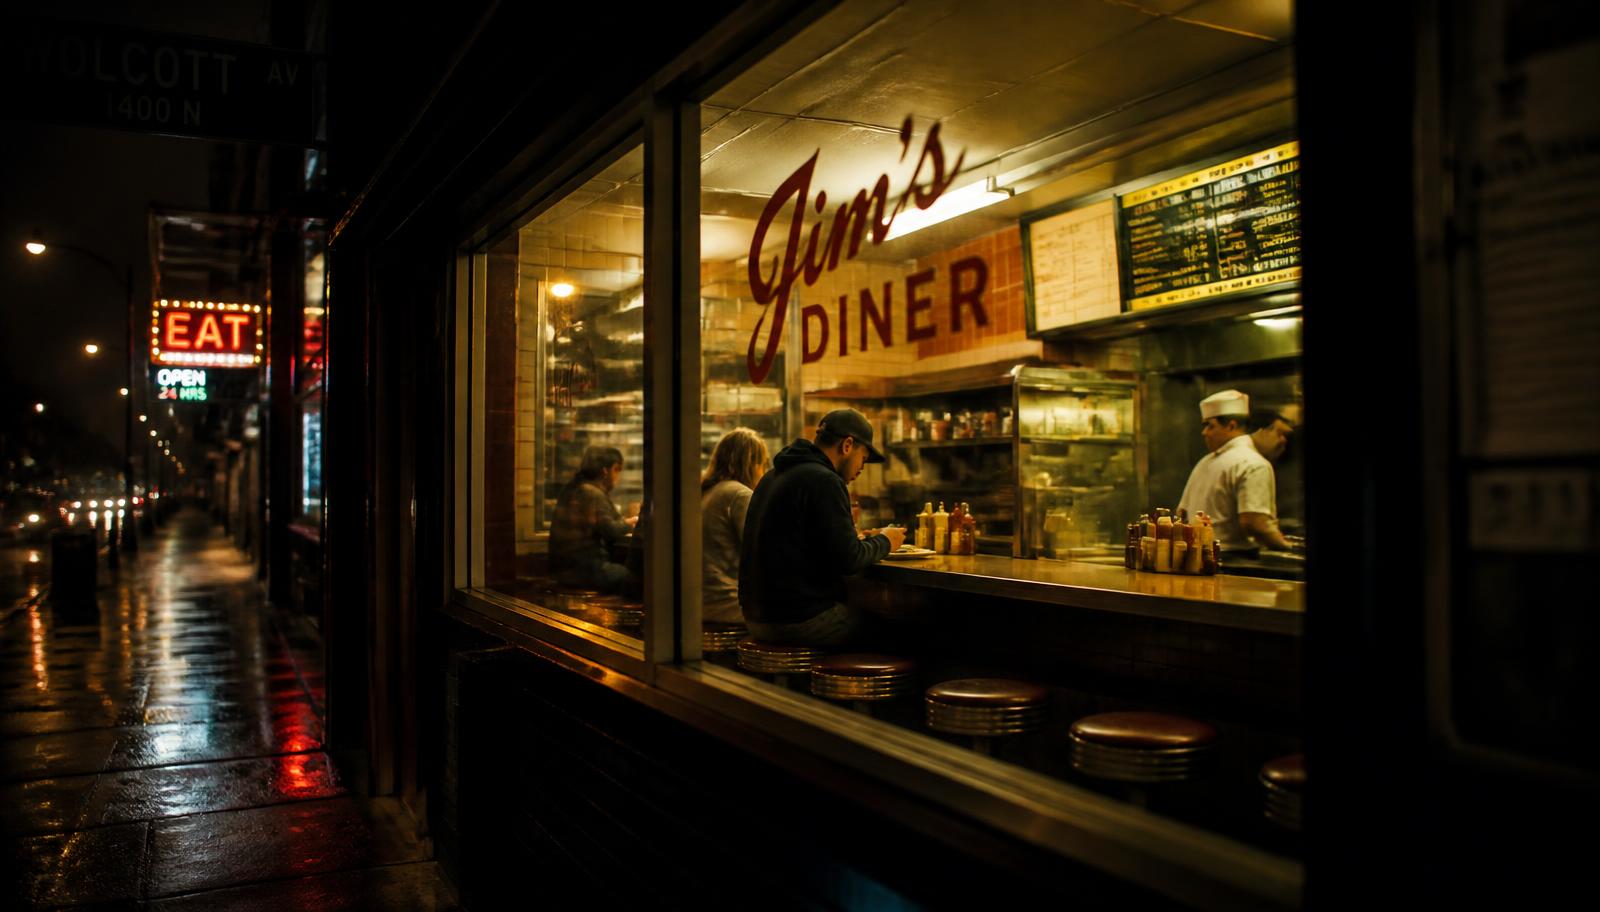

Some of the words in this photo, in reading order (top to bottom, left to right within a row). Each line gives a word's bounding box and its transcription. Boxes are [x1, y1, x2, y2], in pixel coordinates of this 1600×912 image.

[266, 60, 299, 85] AV
[105, 89, 171, 123] 1400
[183, 99, 201, 127] N
[747, 113, 967, 384] Jim's
[801, 255, 989, 364] DINER
[165, 312, 249, 350] EAT
[157, 368, 206, 386] OPEN
[158, 386, 177, 400] 24
[179, 387, 207, 400] HRS
